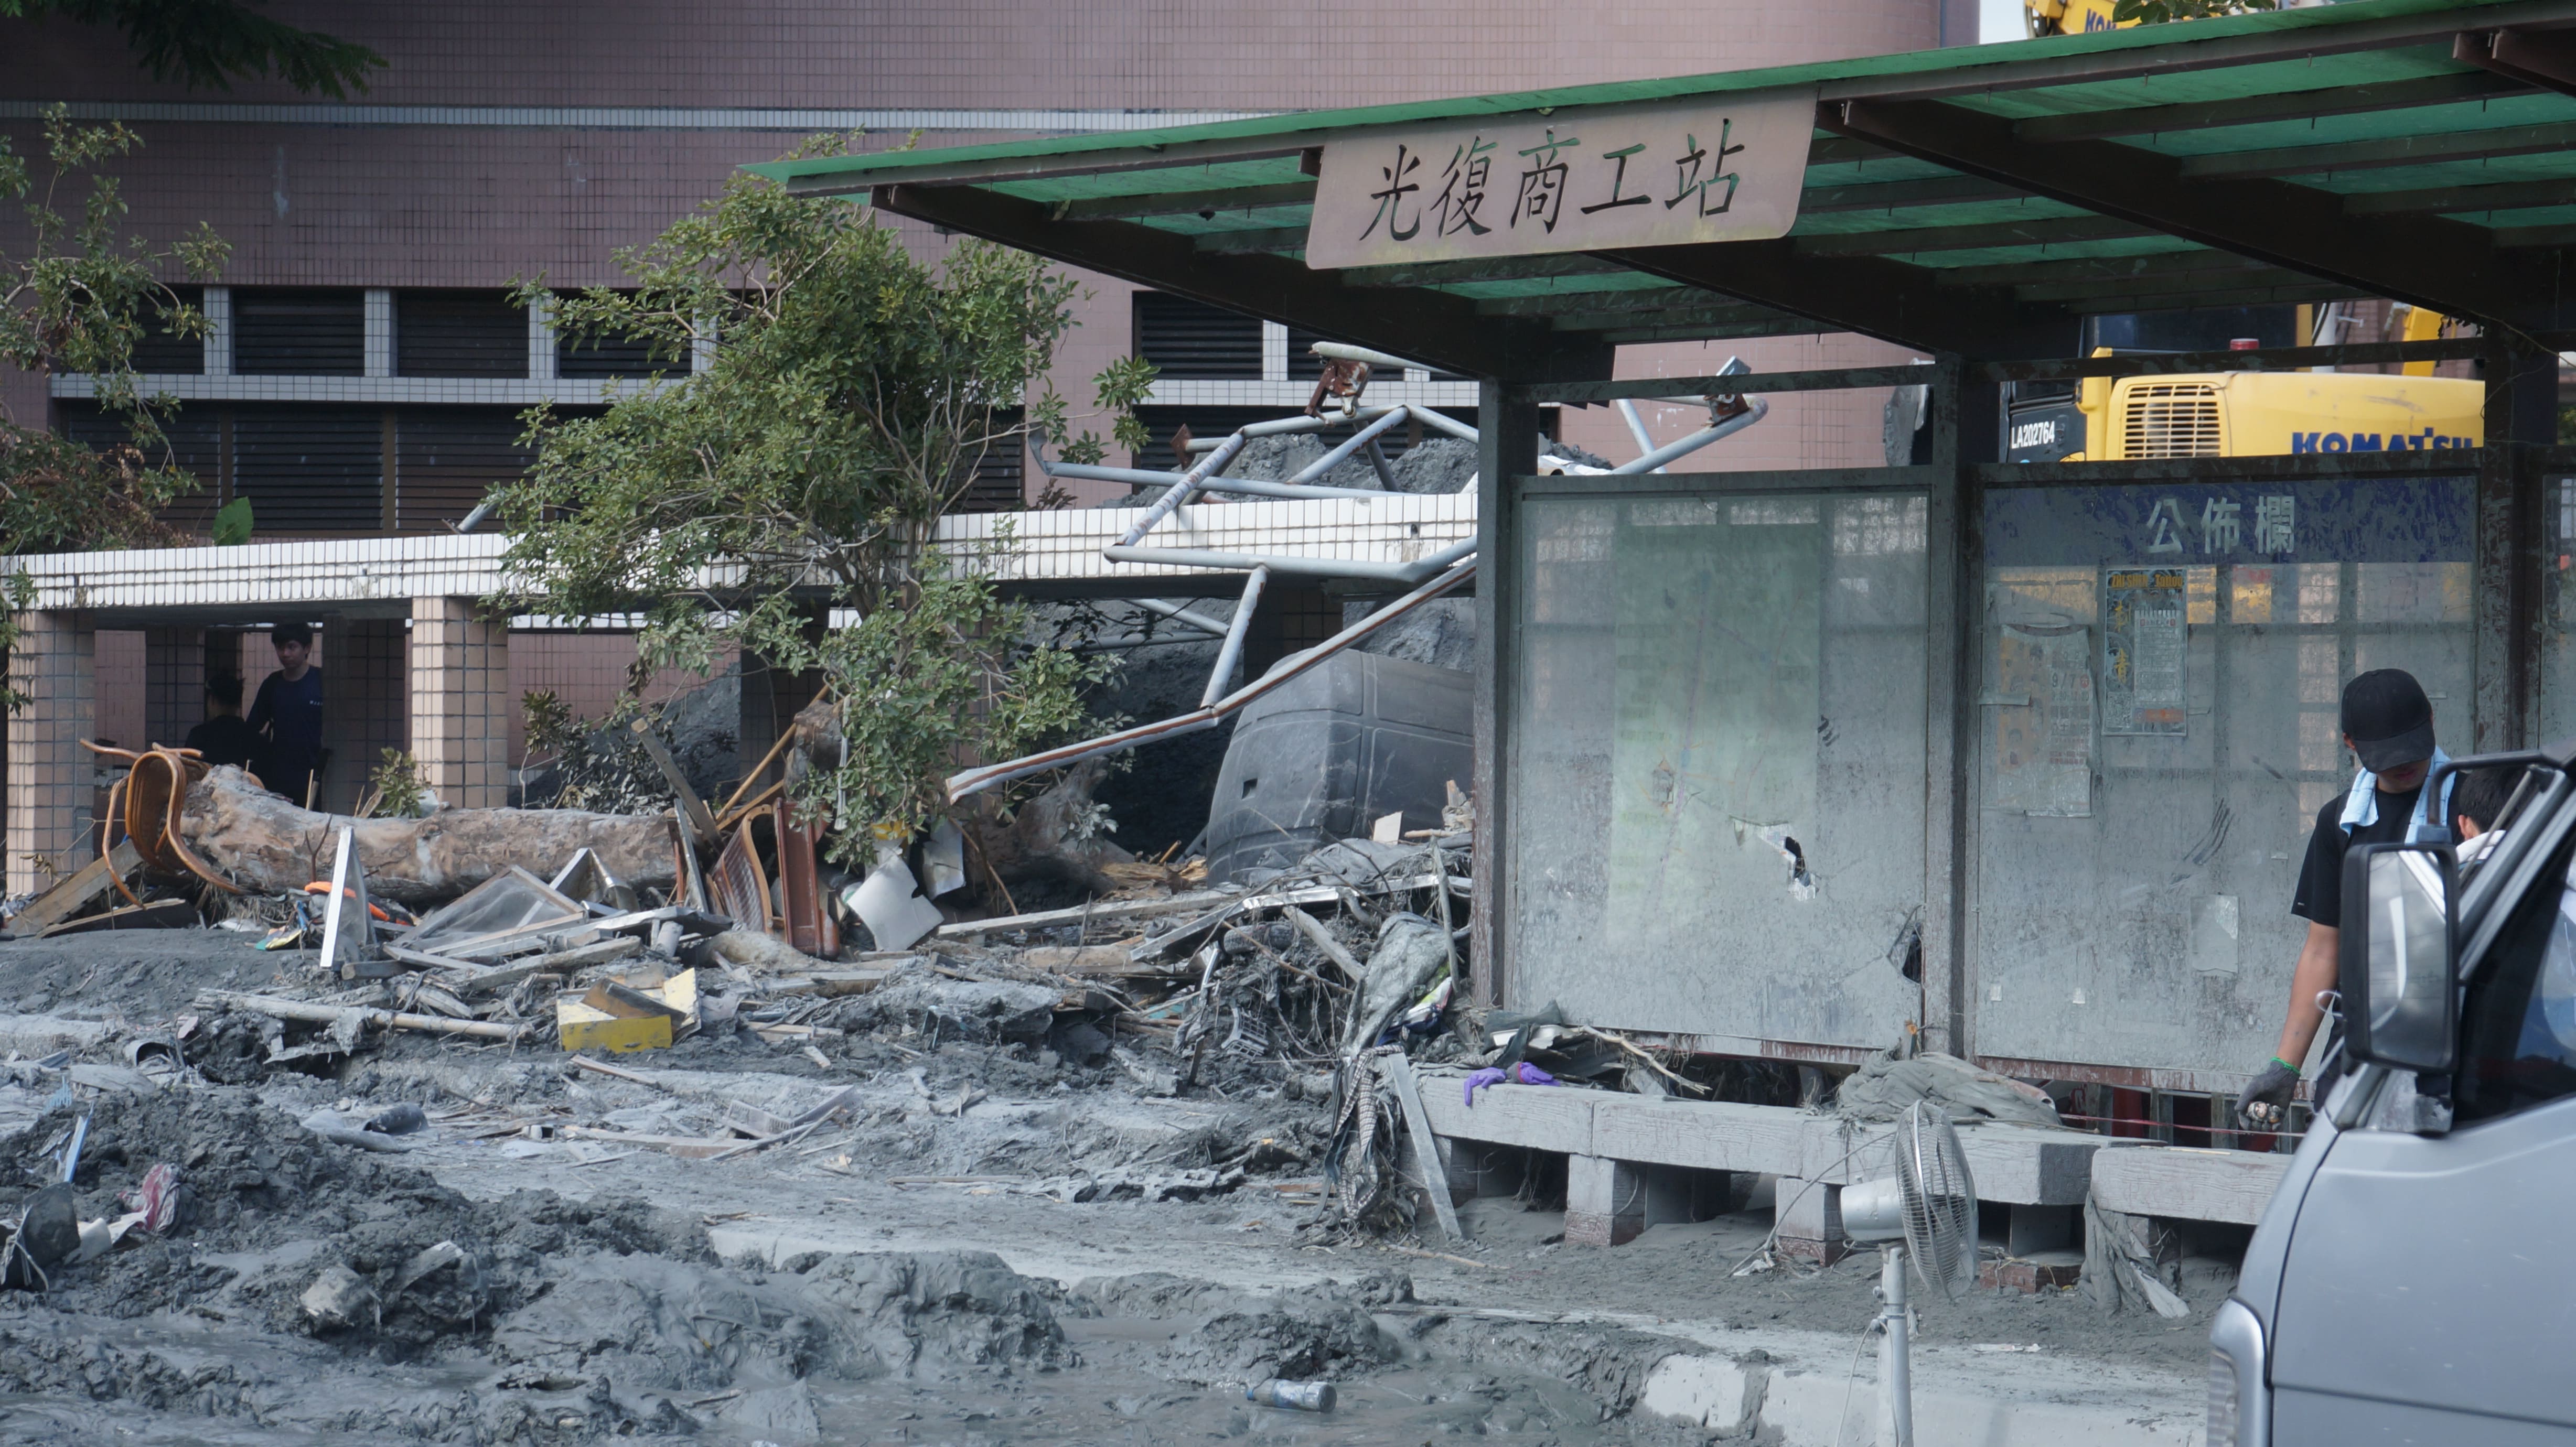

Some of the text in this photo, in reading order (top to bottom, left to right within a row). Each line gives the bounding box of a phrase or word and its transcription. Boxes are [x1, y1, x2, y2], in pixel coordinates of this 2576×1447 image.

[1359, 118, 1745, 241] 光復商工站
[2011, 421, 2055, 449] LA202764
[2147, 495, 2295, 554] 公佈欄
